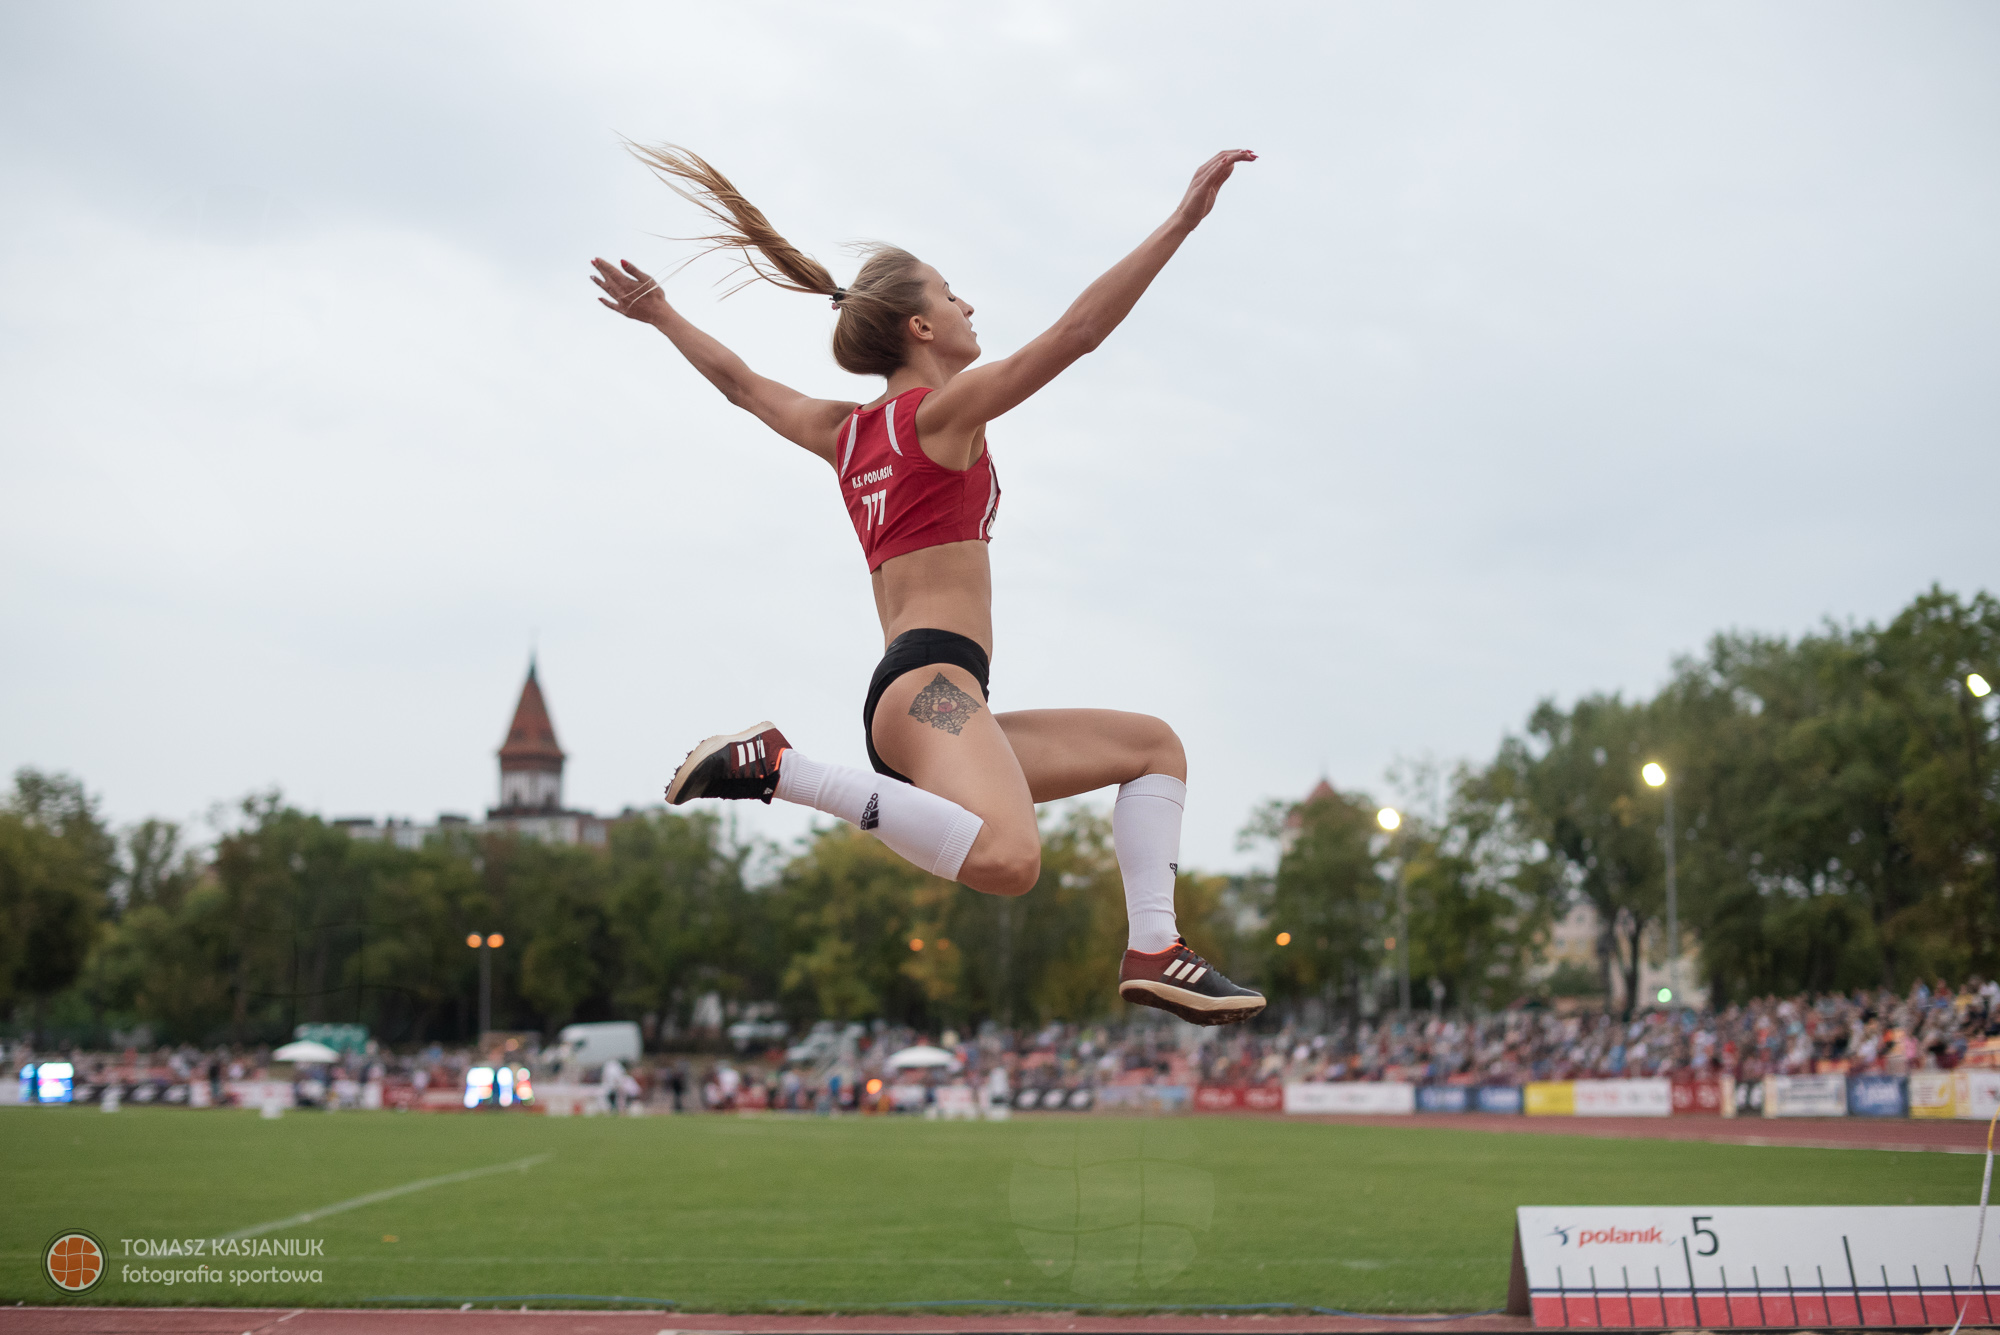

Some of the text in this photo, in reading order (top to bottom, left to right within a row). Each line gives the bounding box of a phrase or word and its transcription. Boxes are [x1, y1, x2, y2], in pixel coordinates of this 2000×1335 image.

[863, 464, 893, 485] PODLASIE
[861, 489, 887, 531] 777
[860, 792, 878, 830] adidas
[1578, 1225, 1662, 1248] polanik
[1692, 1216, 1719, 1256] 5
